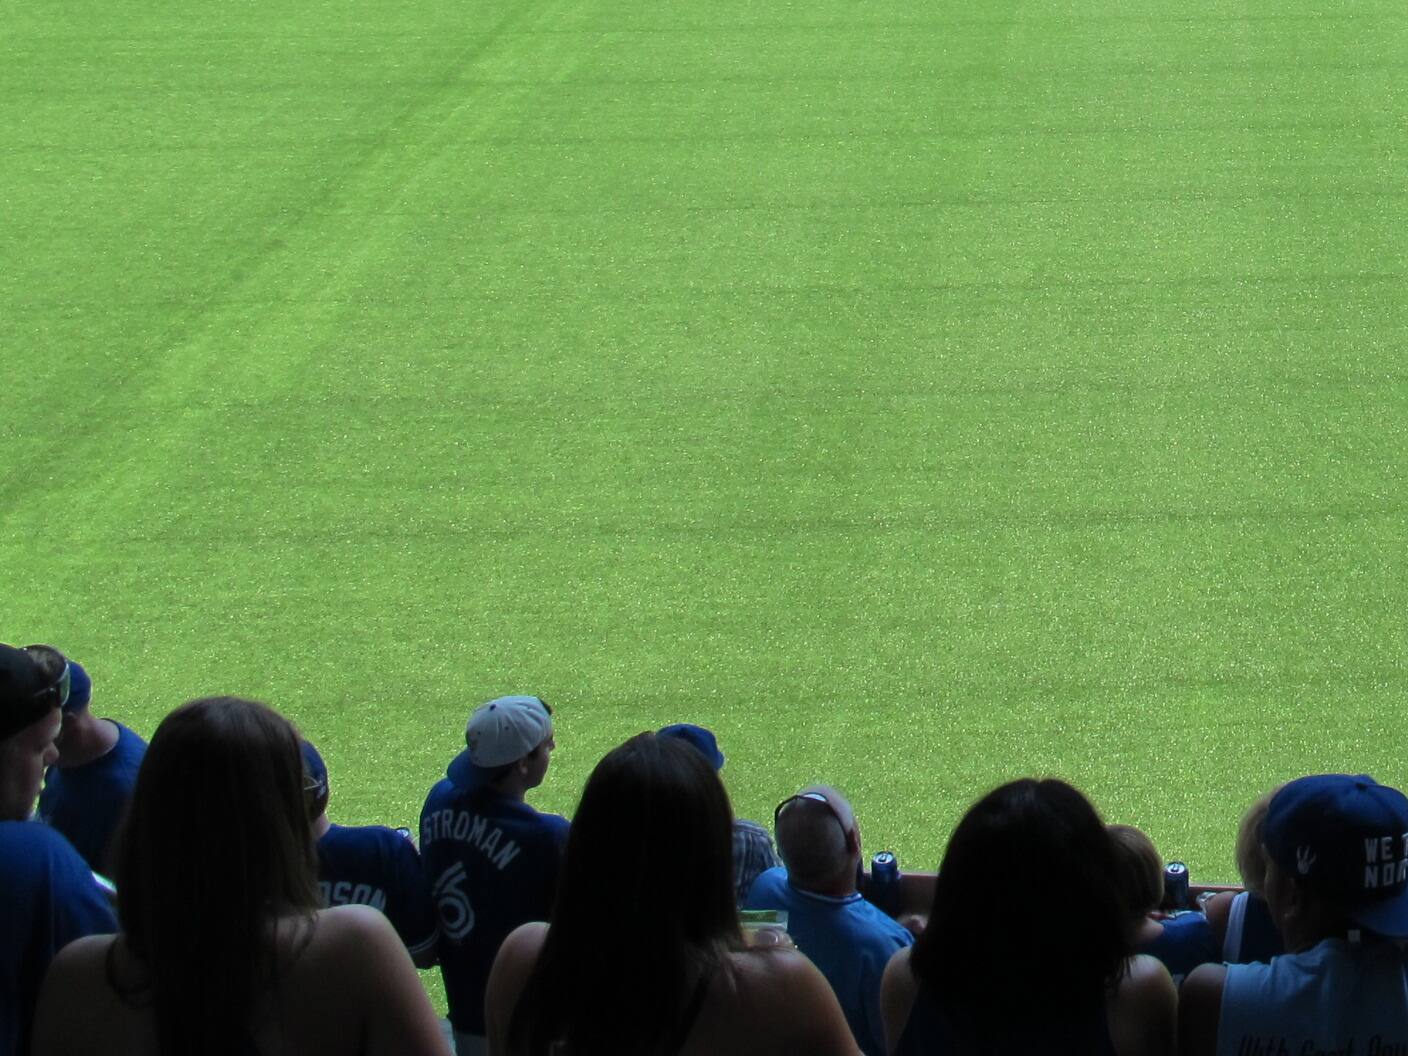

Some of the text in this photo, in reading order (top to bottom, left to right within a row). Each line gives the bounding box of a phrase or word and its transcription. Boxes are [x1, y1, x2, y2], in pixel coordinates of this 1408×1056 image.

[422, 808, 521, 871] STROMAN
[1364, 836, 1393, 864] WE
[431, 860, 476, 940] 6
